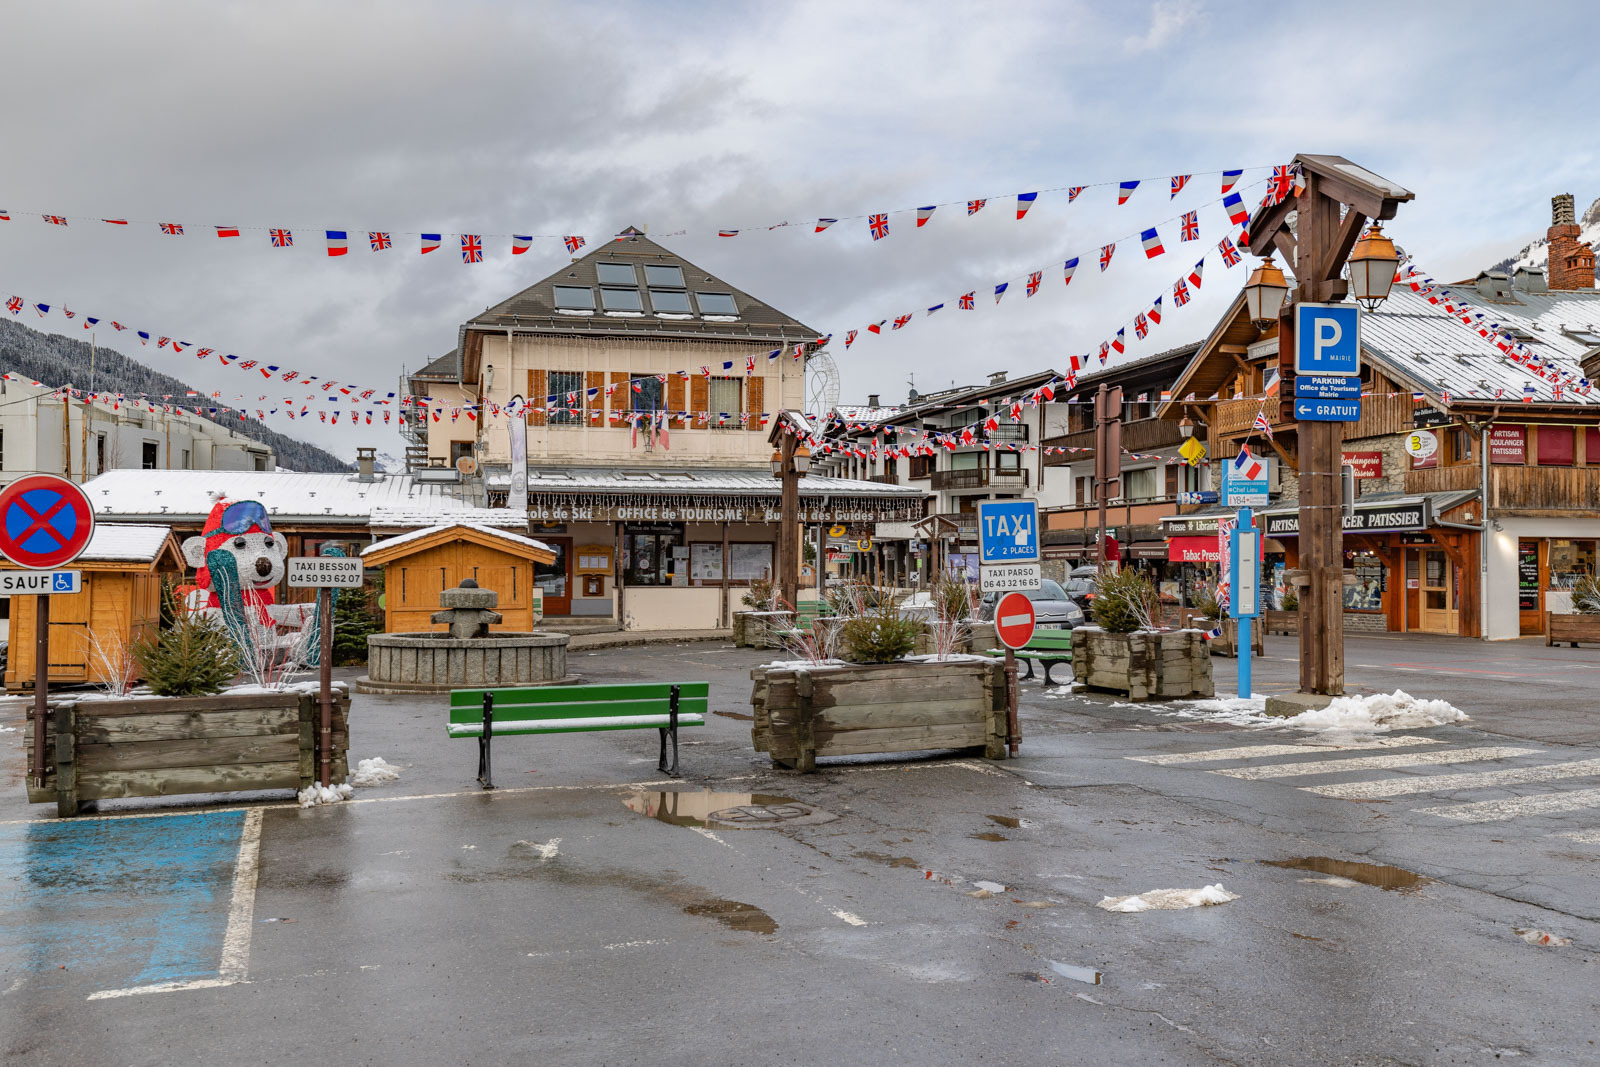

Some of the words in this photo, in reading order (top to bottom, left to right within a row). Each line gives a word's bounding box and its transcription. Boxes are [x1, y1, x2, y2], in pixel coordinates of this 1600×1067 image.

[1314, 317, 1342, 361] P
[1312, 377, 1347, 385] PARKING
[1316, 405, 1358, 416] GRATUIT
[1494, 430, 1519, 438] ARTISAN
[1490, 439, 1524, 447] BOULANGER
[1190, 448, 1205, 465] PRESSE
[1492, 447, 1522, 455] PATISSIER
[1232, 496, 1246, 505] Y84
[553, 507, 568, 519] de
[572, 507, 593, 519] Ski
[617, 507, 658, 520] OFFICE
[661, 508, 676, 520] de
[680, 508, 743, 520] TOURISME
[811, 511, 831, 521] des
[835, 510, 874, 521] Guides
[984, 513, 1032, 537] TAXI
[1368, 512, 1420, 527] PATISSIER
[1169, 522, 1186, 532] Presse
[1196, 521, 1219, 531] Librairie
[1002, 547, 1008, 555] 2
[1010, 546, 1035, 555] PLACES
[1183, 549, 1201, 561] Tabac
[295, 562, 316, 571] TAXI
[319, 562, 357, 571] BESSON
[988, 569, 1006, 577] TAXI
[1007, 568, 1034, 577] PARSO
[3, 575, 50, 589] SAUF
[290, 574, 303, 583] 04
[306, 574, 318, 583] 50
[320, 574, 332, 583] 93
[334, 574, 347, 583] 62
[348, 574, 360, 583] 07
[983, 580, 994, 588] 06
[995, 579, 1006, 587] 43
[1007, 579, 1018, 587] 32
[1019, 578, 1028, 587] 16
[1028, 578, 1039, 586] 65
